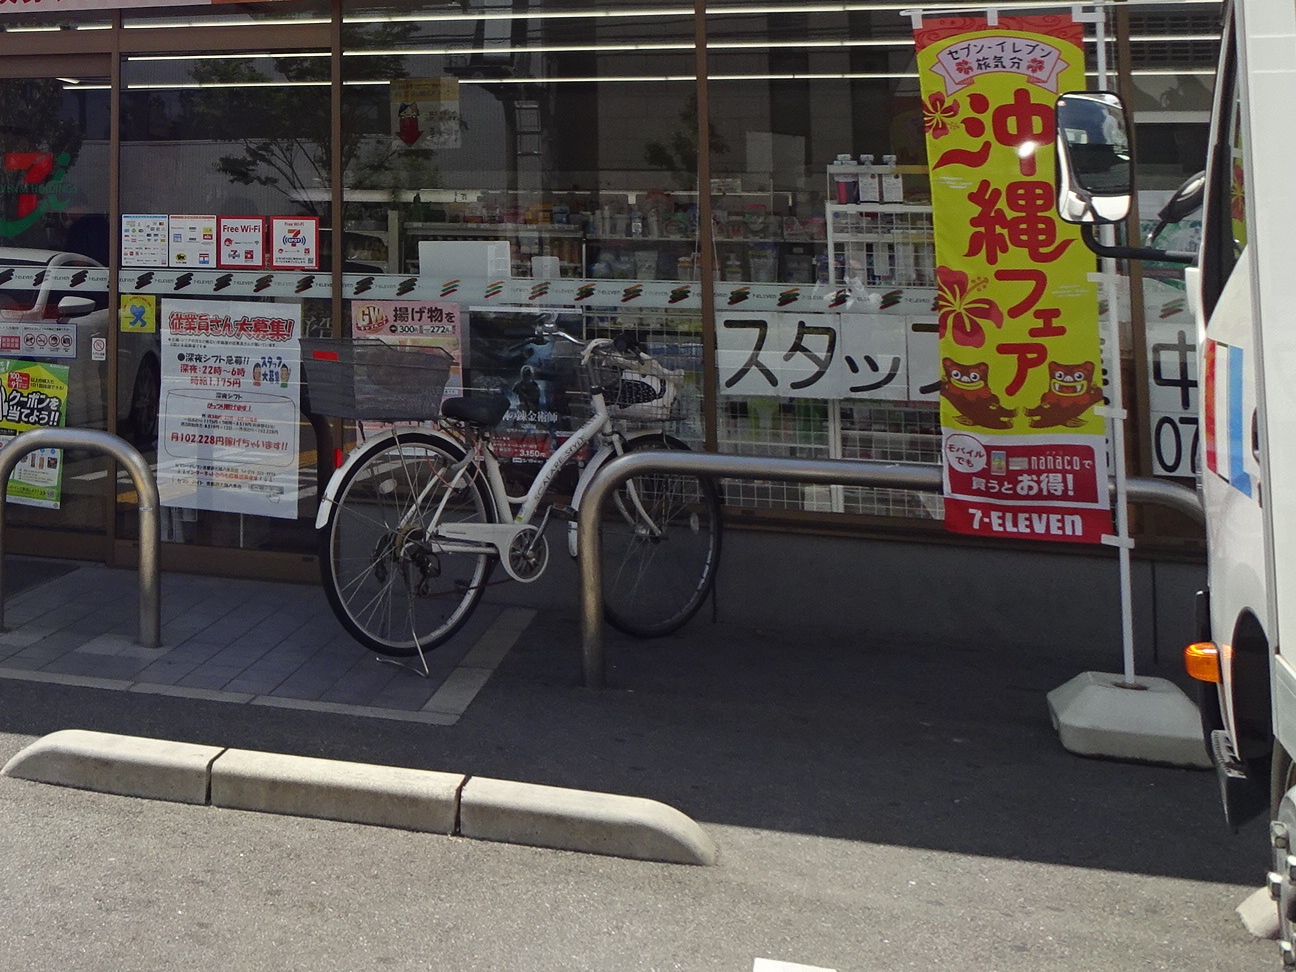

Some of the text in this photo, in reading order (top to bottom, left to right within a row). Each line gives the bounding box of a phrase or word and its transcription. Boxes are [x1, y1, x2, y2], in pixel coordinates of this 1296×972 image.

[975, 55, 1023, 70] 旅気分
[222, 224, 261, 233] Free Wi-Fi
[932, 88, 1078, 396] 沖縄フェア
[392, 306, 456, 323] 揚げ物を
[8, 389, 61, 411] クーポンを
[947, 444, 985, 459] モバイル
[955, 456, 974, 468] でも
[971, 473, 1074, 496] 買うとお得!
